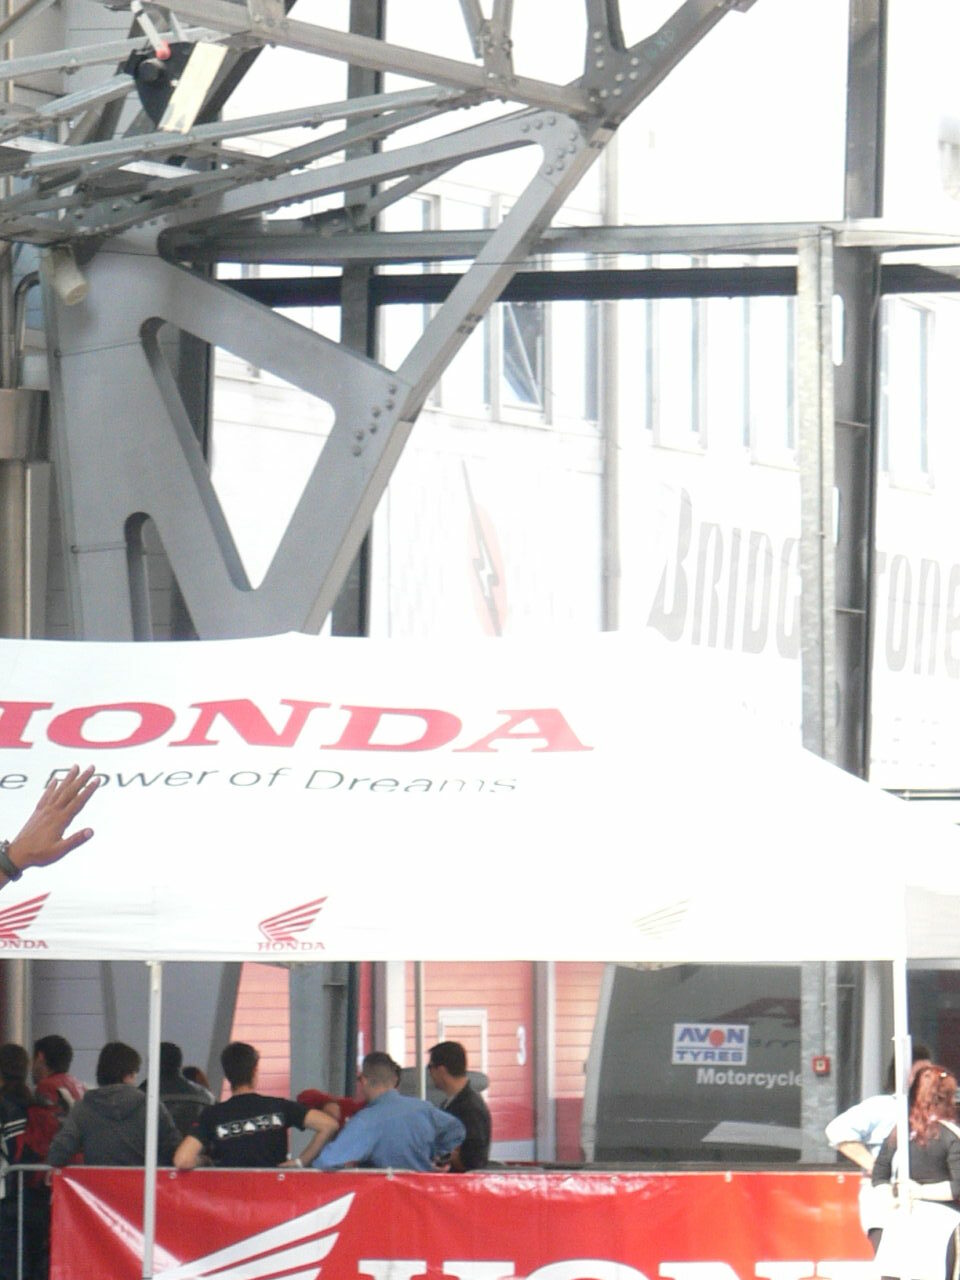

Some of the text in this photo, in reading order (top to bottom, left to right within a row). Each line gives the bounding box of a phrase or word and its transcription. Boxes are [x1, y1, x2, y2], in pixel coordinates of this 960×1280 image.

[230, 767, 291, 787] of
[305, 770, 516, 793] Dreams
[258, 942, 326, 951] HONDA
[679, 1027, 745, 1047] AVON
[677, 1051, 743, 1063] TYRES
